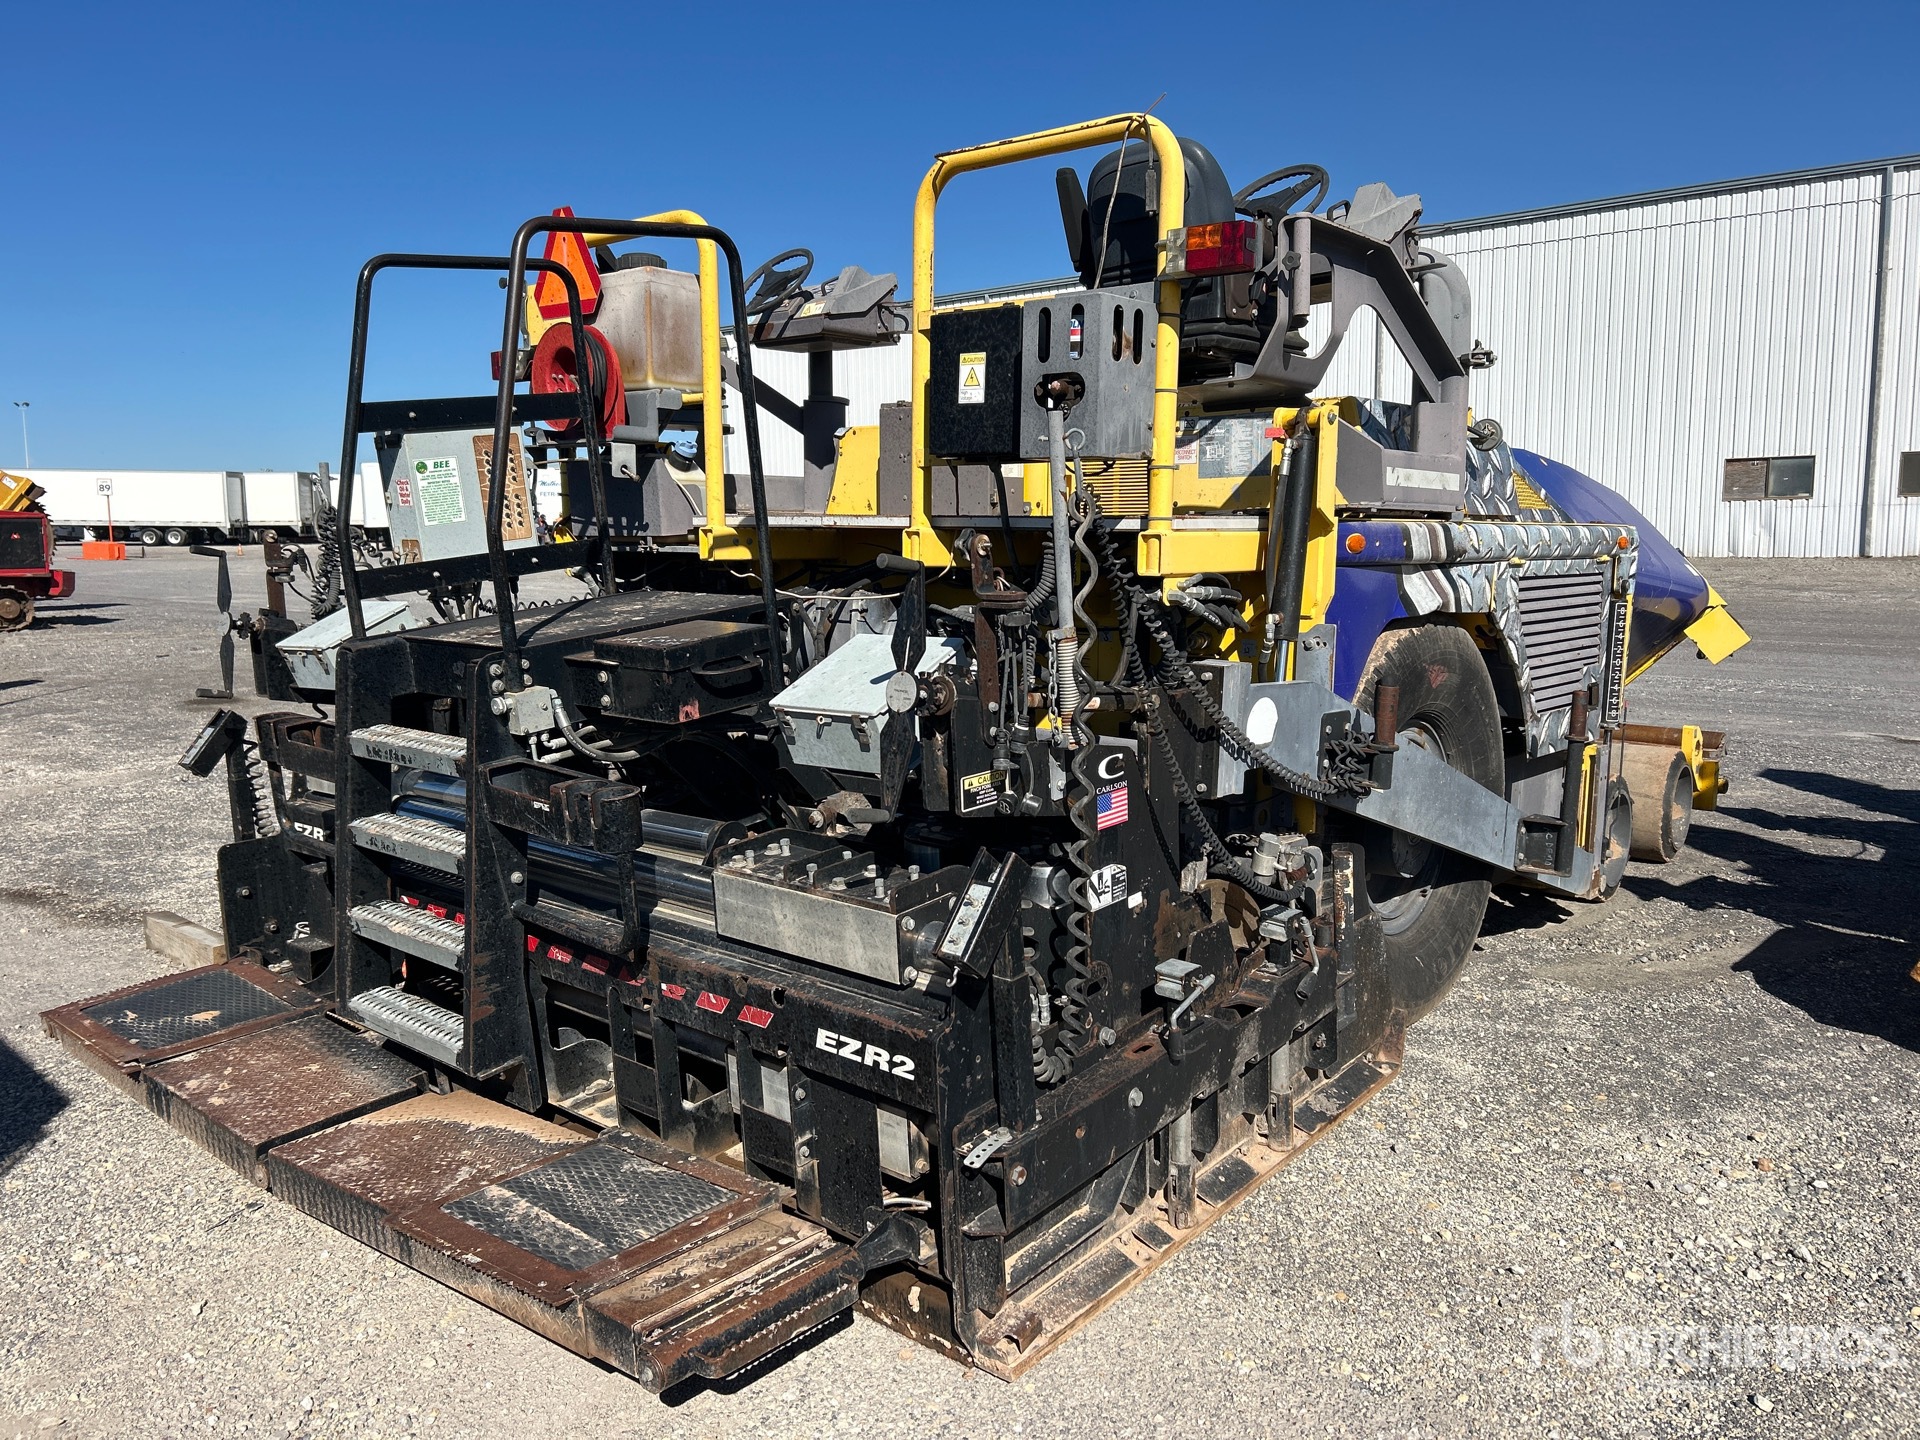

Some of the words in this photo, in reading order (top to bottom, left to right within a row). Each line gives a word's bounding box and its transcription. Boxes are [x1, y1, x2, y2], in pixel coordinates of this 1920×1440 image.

[433, 460, 450, 469] BEE
[1098, 753, 1124, 779] C
[978, 771, 1004, 784] CAUTION
[1096, 780, 1128, 794] CARLSON
[294, 822, 325, 841] EZR
[815, 1027, 915, 1081] EZR2
